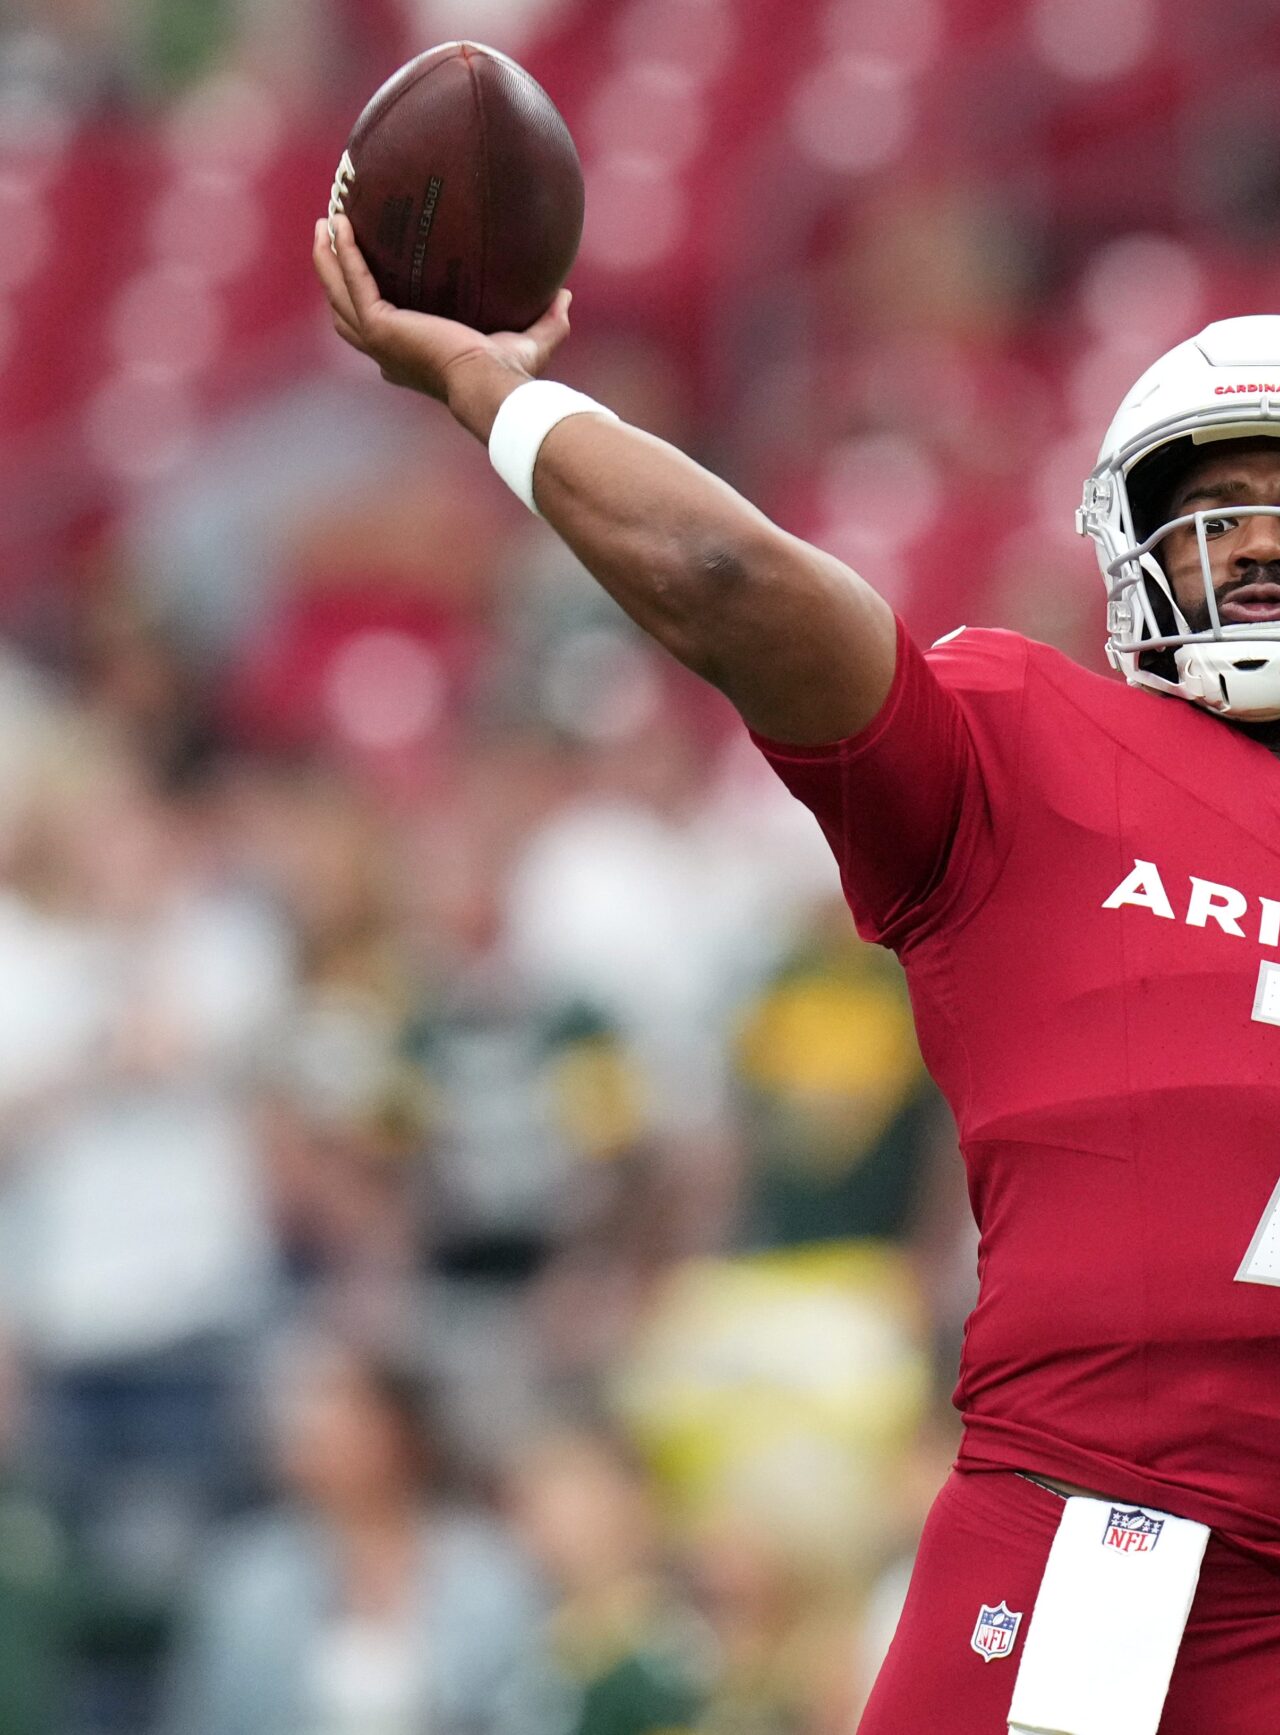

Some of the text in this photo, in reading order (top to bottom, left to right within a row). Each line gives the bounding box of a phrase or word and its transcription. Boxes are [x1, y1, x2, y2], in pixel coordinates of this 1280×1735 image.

[420, 177, 440, 237] LEAGUE
[1107, 1528, 1149, 1552] NFL
[978, 1629, 1007, 1651] NFL
